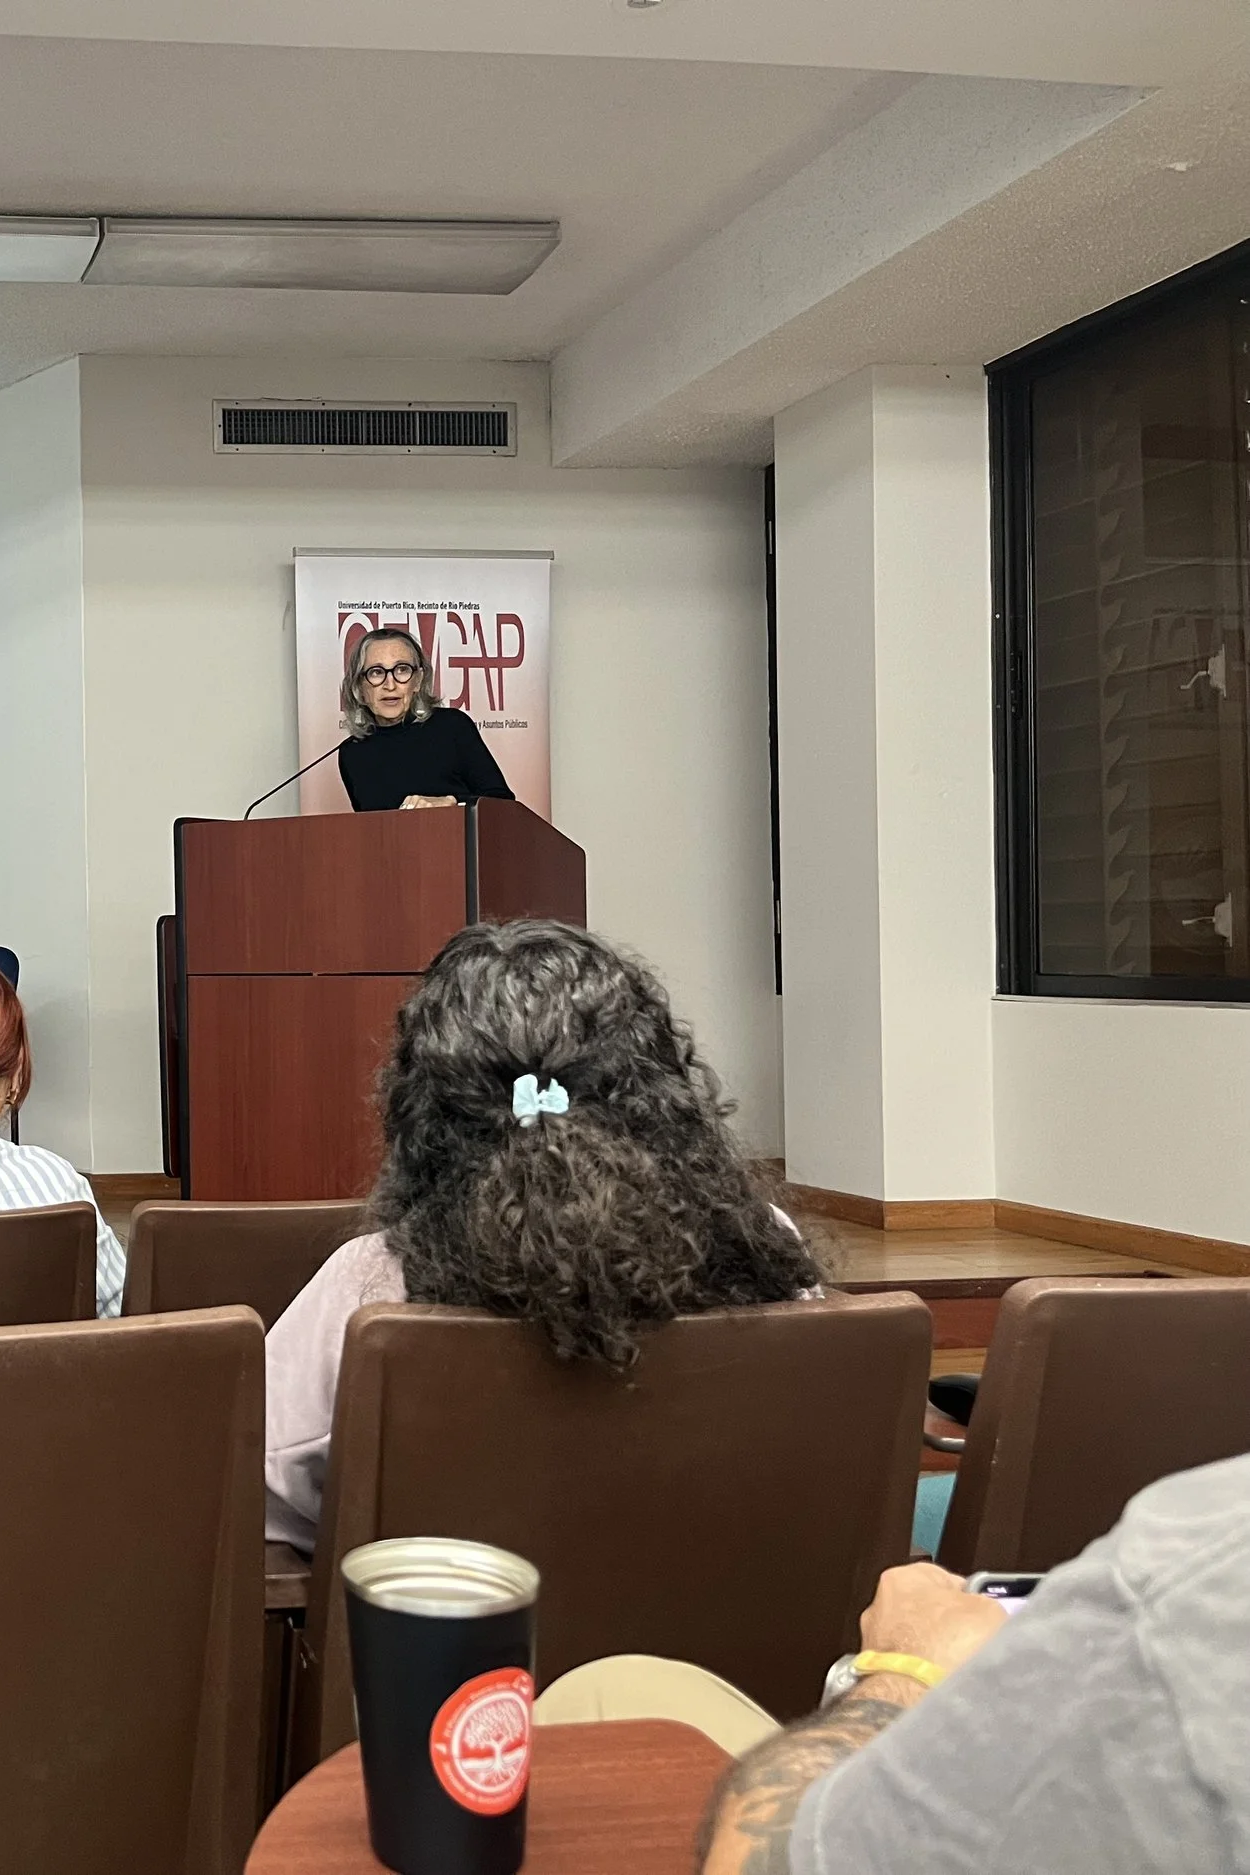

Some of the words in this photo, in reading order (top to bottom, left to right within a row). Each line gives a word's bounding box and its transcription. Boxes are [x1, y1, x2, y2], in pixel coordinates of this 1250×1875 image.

[338, 601, 372, 610] Universidad
[373, 601, 380, 610] de
[382, 601, 402, 610] Puerto
[402, 601, 416, 611] Rica,
[418, 601, 438, 610] Recinto
[440, 601, 448, 610] de
[459, 601, 480, 611] Piedras
[482, 719, 504, 729] Asuntos
[505, 718, 528, 729] Públicos
